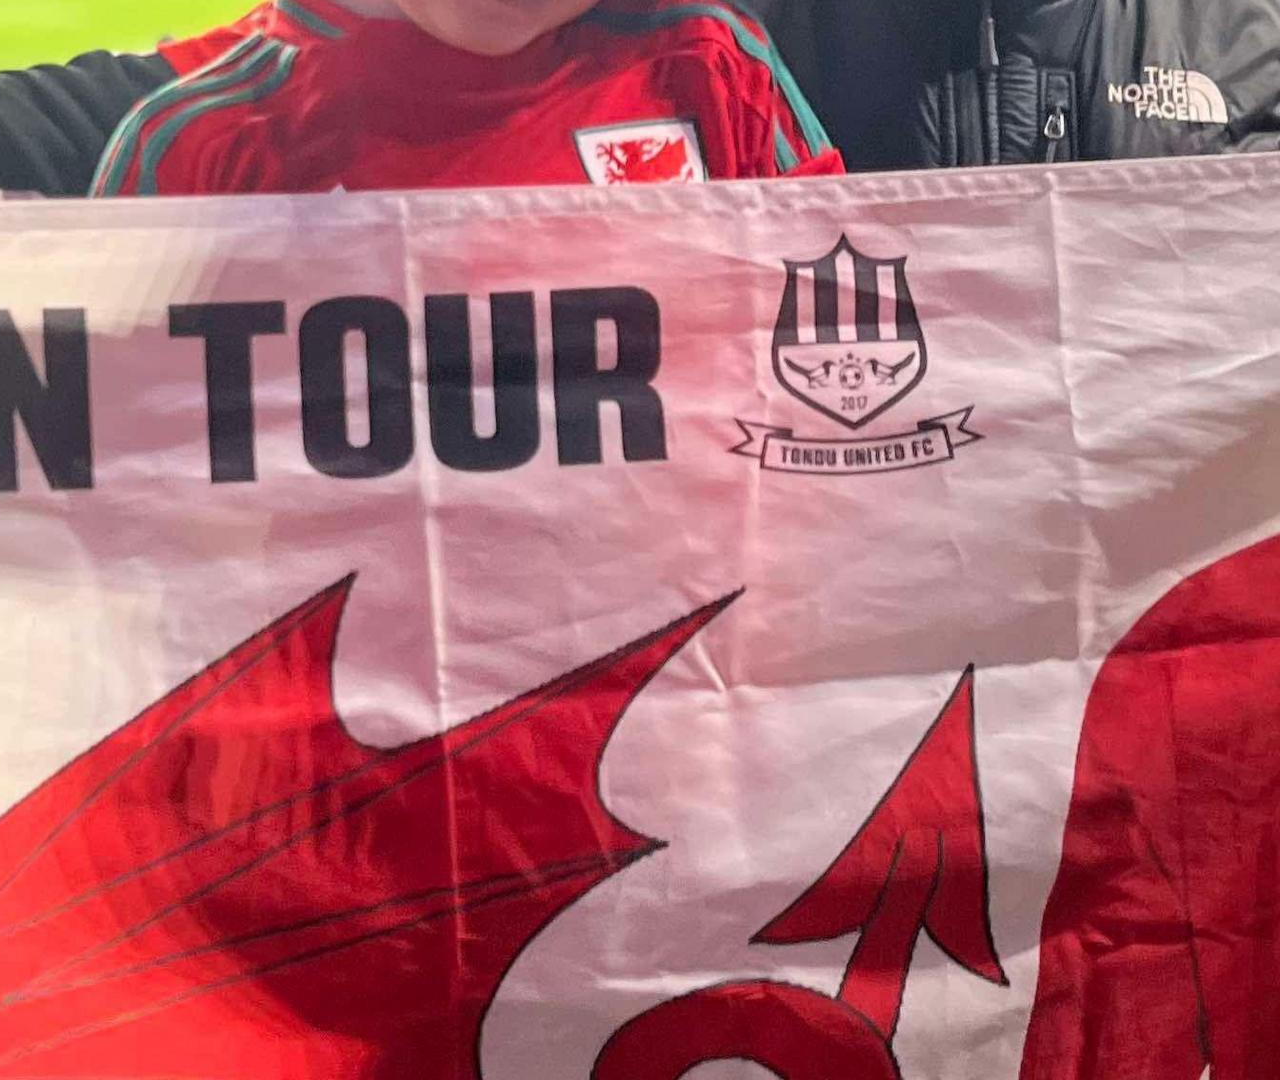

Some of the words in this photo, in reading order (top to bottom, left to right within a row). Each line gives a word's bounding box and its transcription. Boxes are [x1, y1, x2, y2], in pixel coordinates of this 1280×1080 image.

[1143, 66, 1187, 87] THE
[1107, 83, 1188, 104] NORTH
[1135, 100, 1190, 121] FACE
[168, 285, 668, 485] TOUR
[840, 396, 869, 411] 2017
[780, 445, 837, 467] TONDU
[843, 442, 906, 467] UNITED
[911, 438, 935, 459] FC
